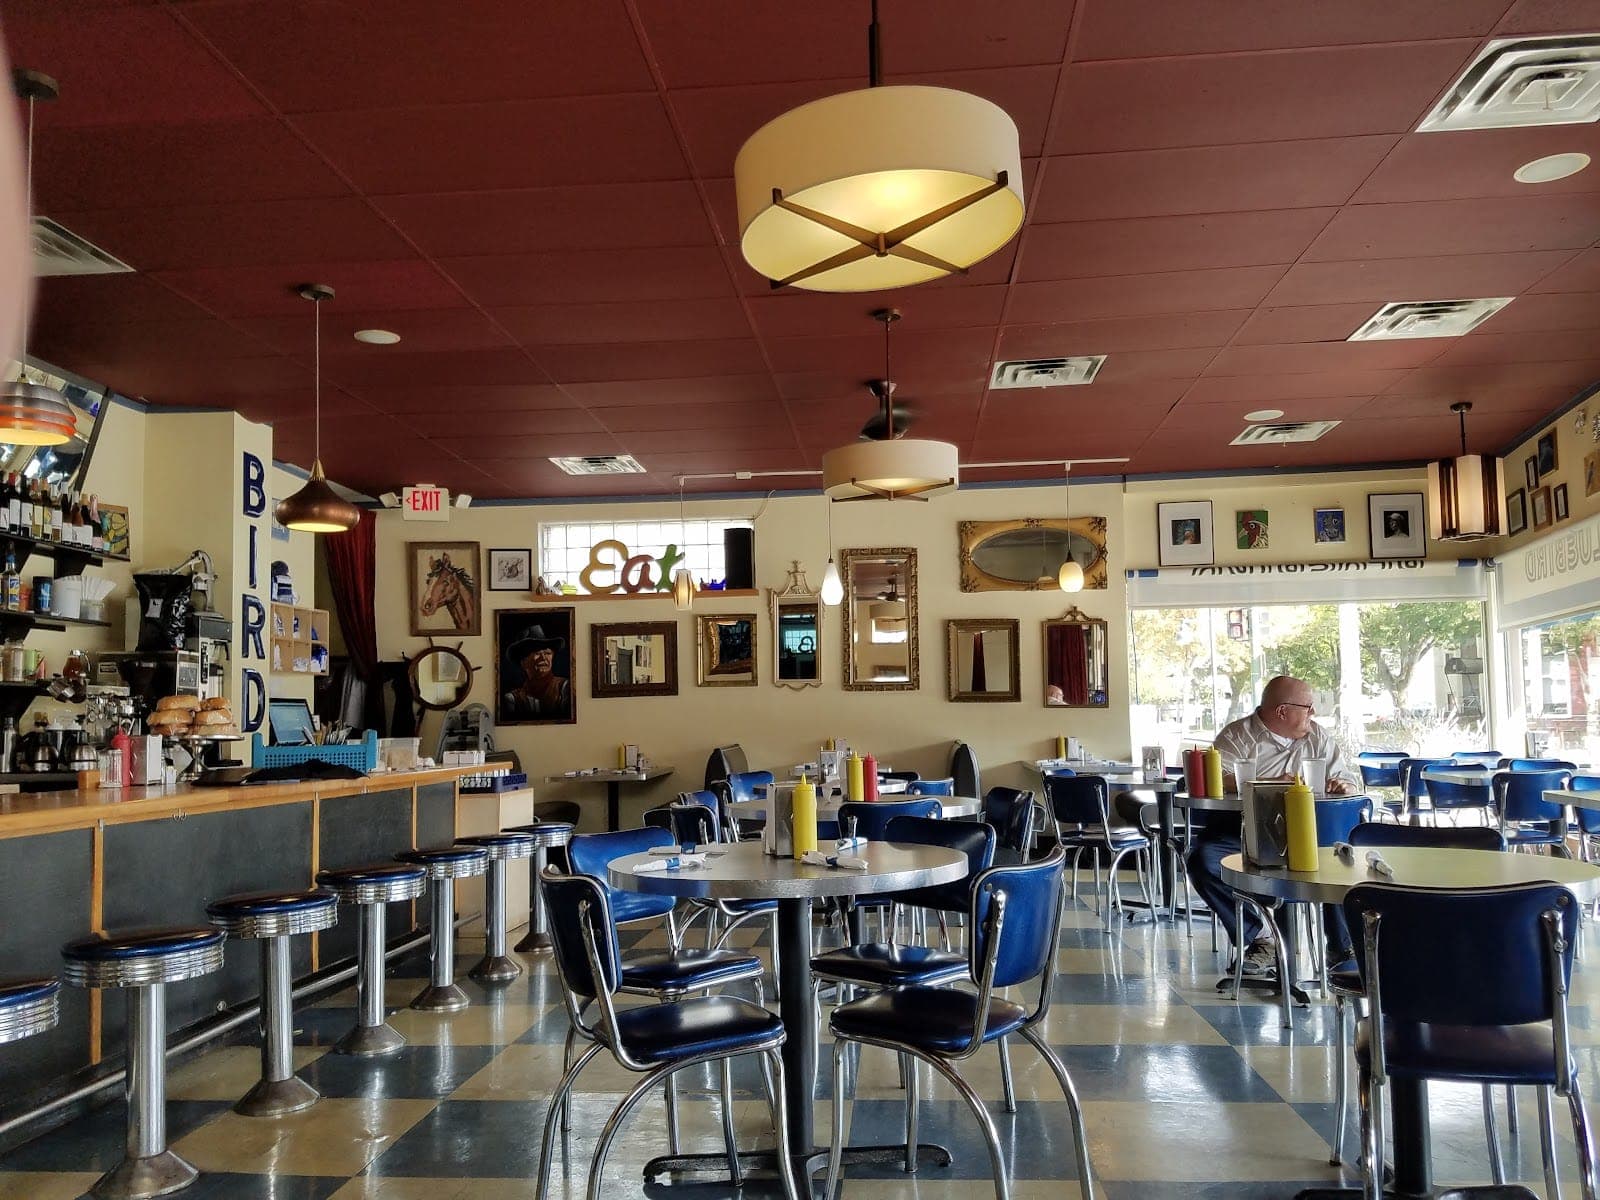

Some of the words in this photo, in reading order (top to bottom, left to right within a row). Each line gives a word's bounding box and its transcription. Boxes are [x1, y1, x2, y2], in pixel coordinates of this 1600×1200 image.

[412, 491, 441, 511] EXIT
[241, 451, 267, 733] BIRD
[579, 539, 686, 594] Eat
